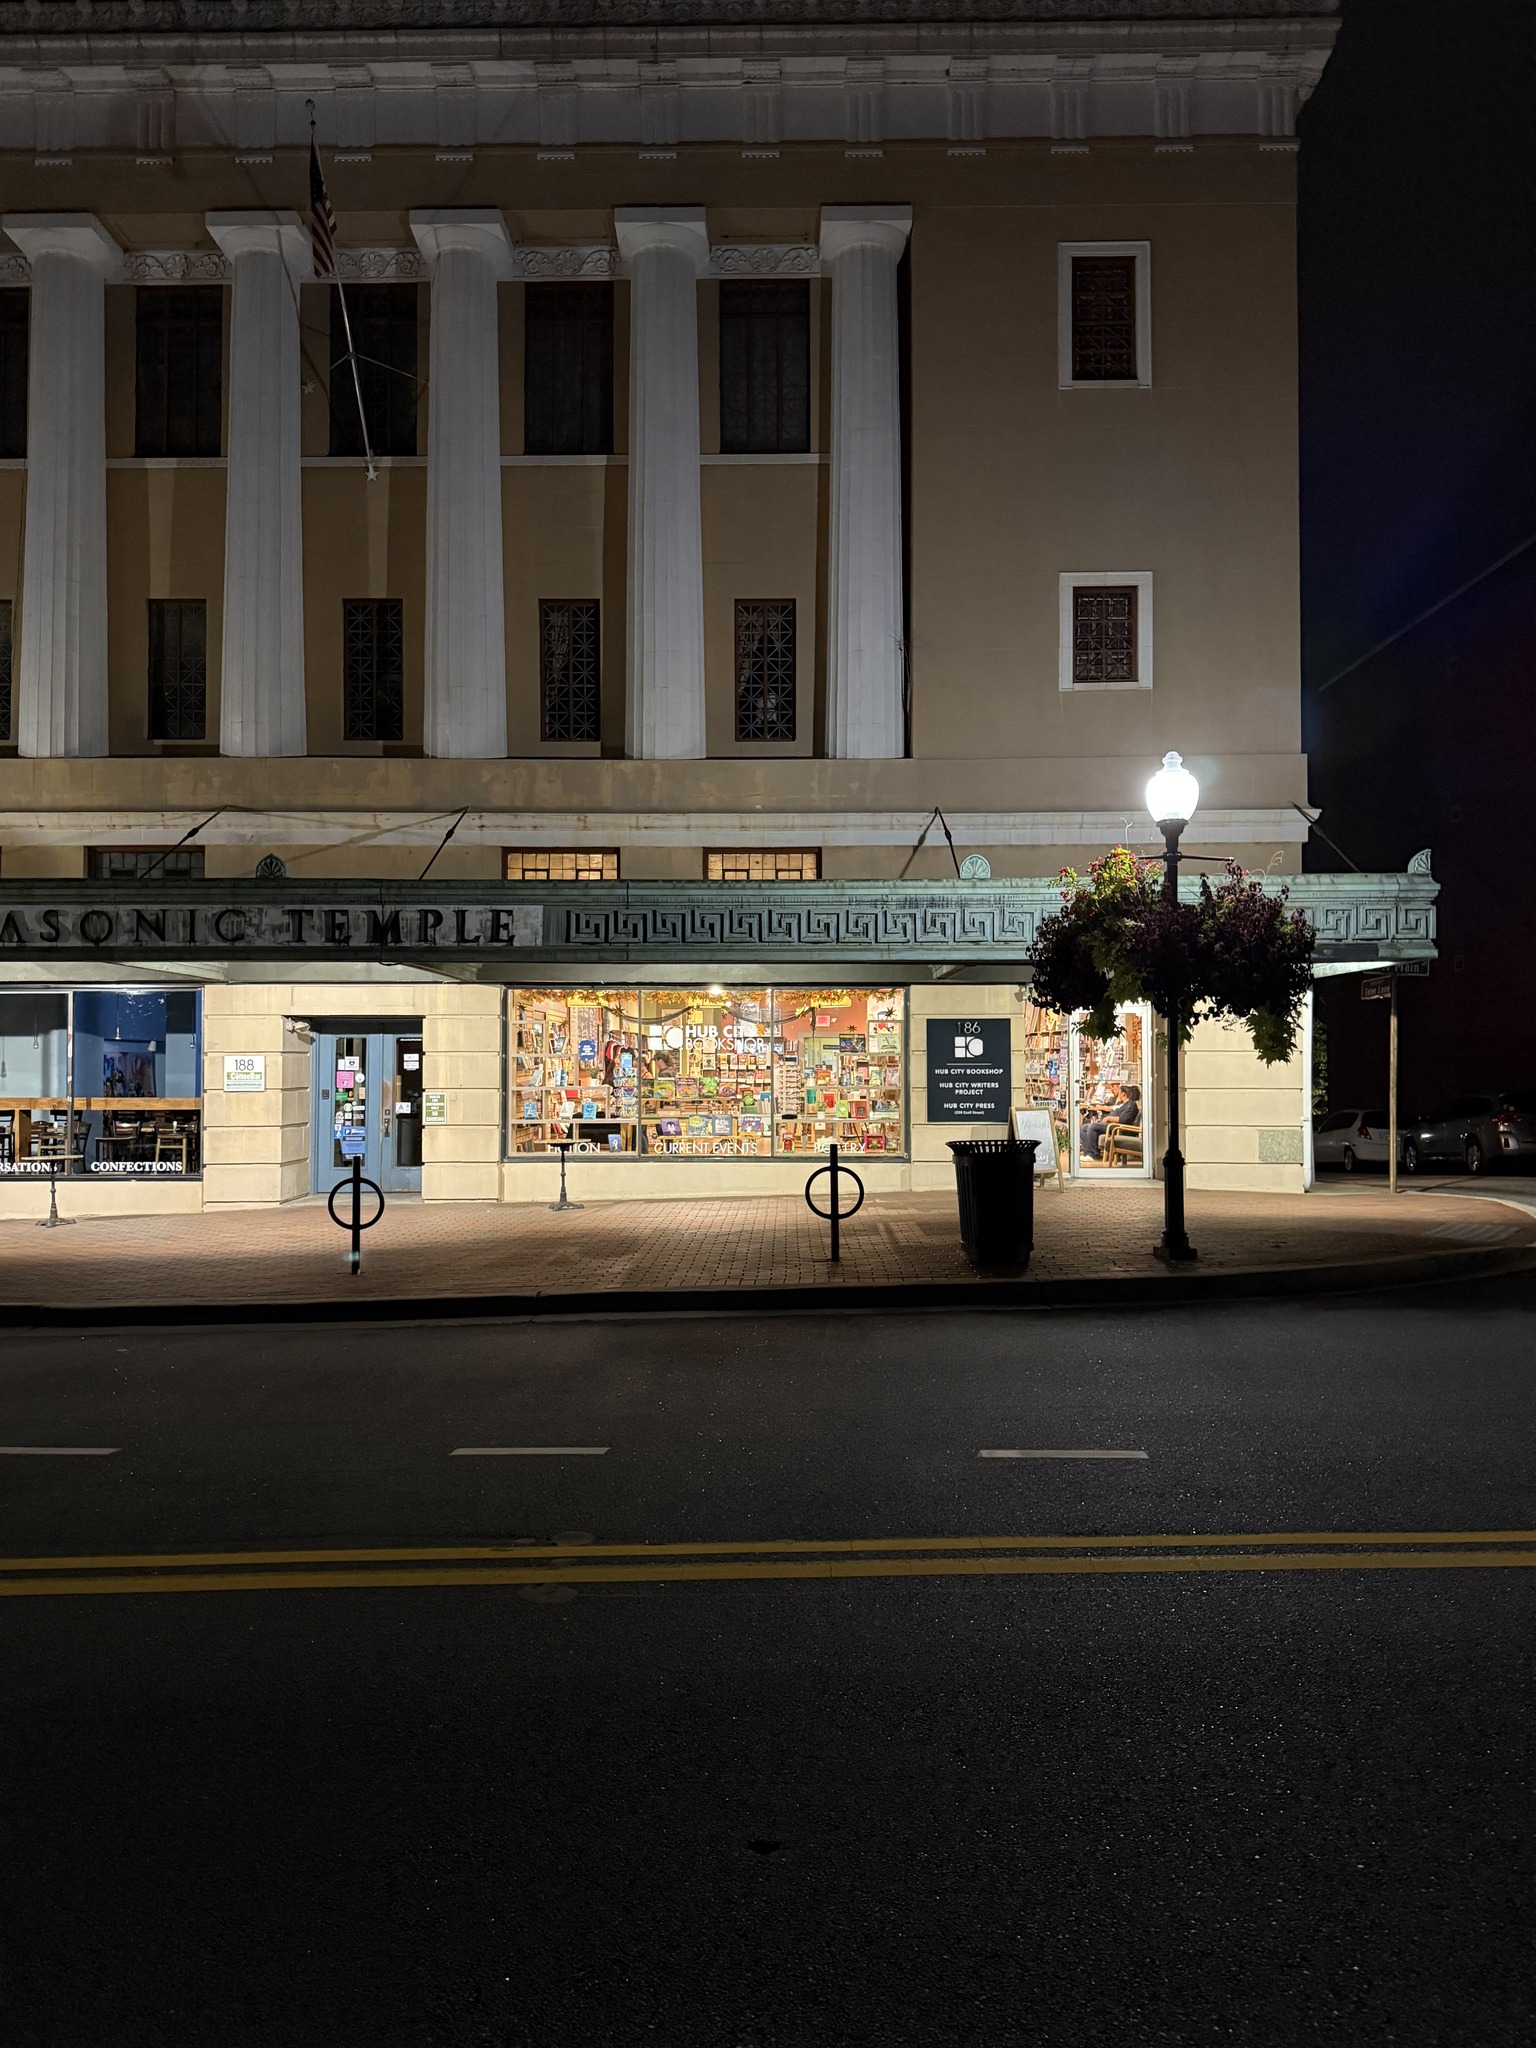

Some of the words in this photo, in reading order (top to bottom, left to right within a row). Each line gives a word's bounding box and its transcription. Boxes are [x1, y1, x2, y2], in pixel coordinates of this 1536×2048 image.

[0, 908, 248, 945] ASONIC
[286, 908, 516, 945] TEMPLE
[685, 1025, 718, 1038] HUB
[957, 1021, 981, 1034] 186
[685, 1038, 765, 1051] BOOKSHOP
[234, 1059, 255, 1071] 188
[654, 1142, 709, 1154] CURRENT
[712, 1142, 758, 1154] EVENTS
[0, 1162, 58, 1173] RSATION
[90, 1161, 183, 1173] CONFECTIONS
